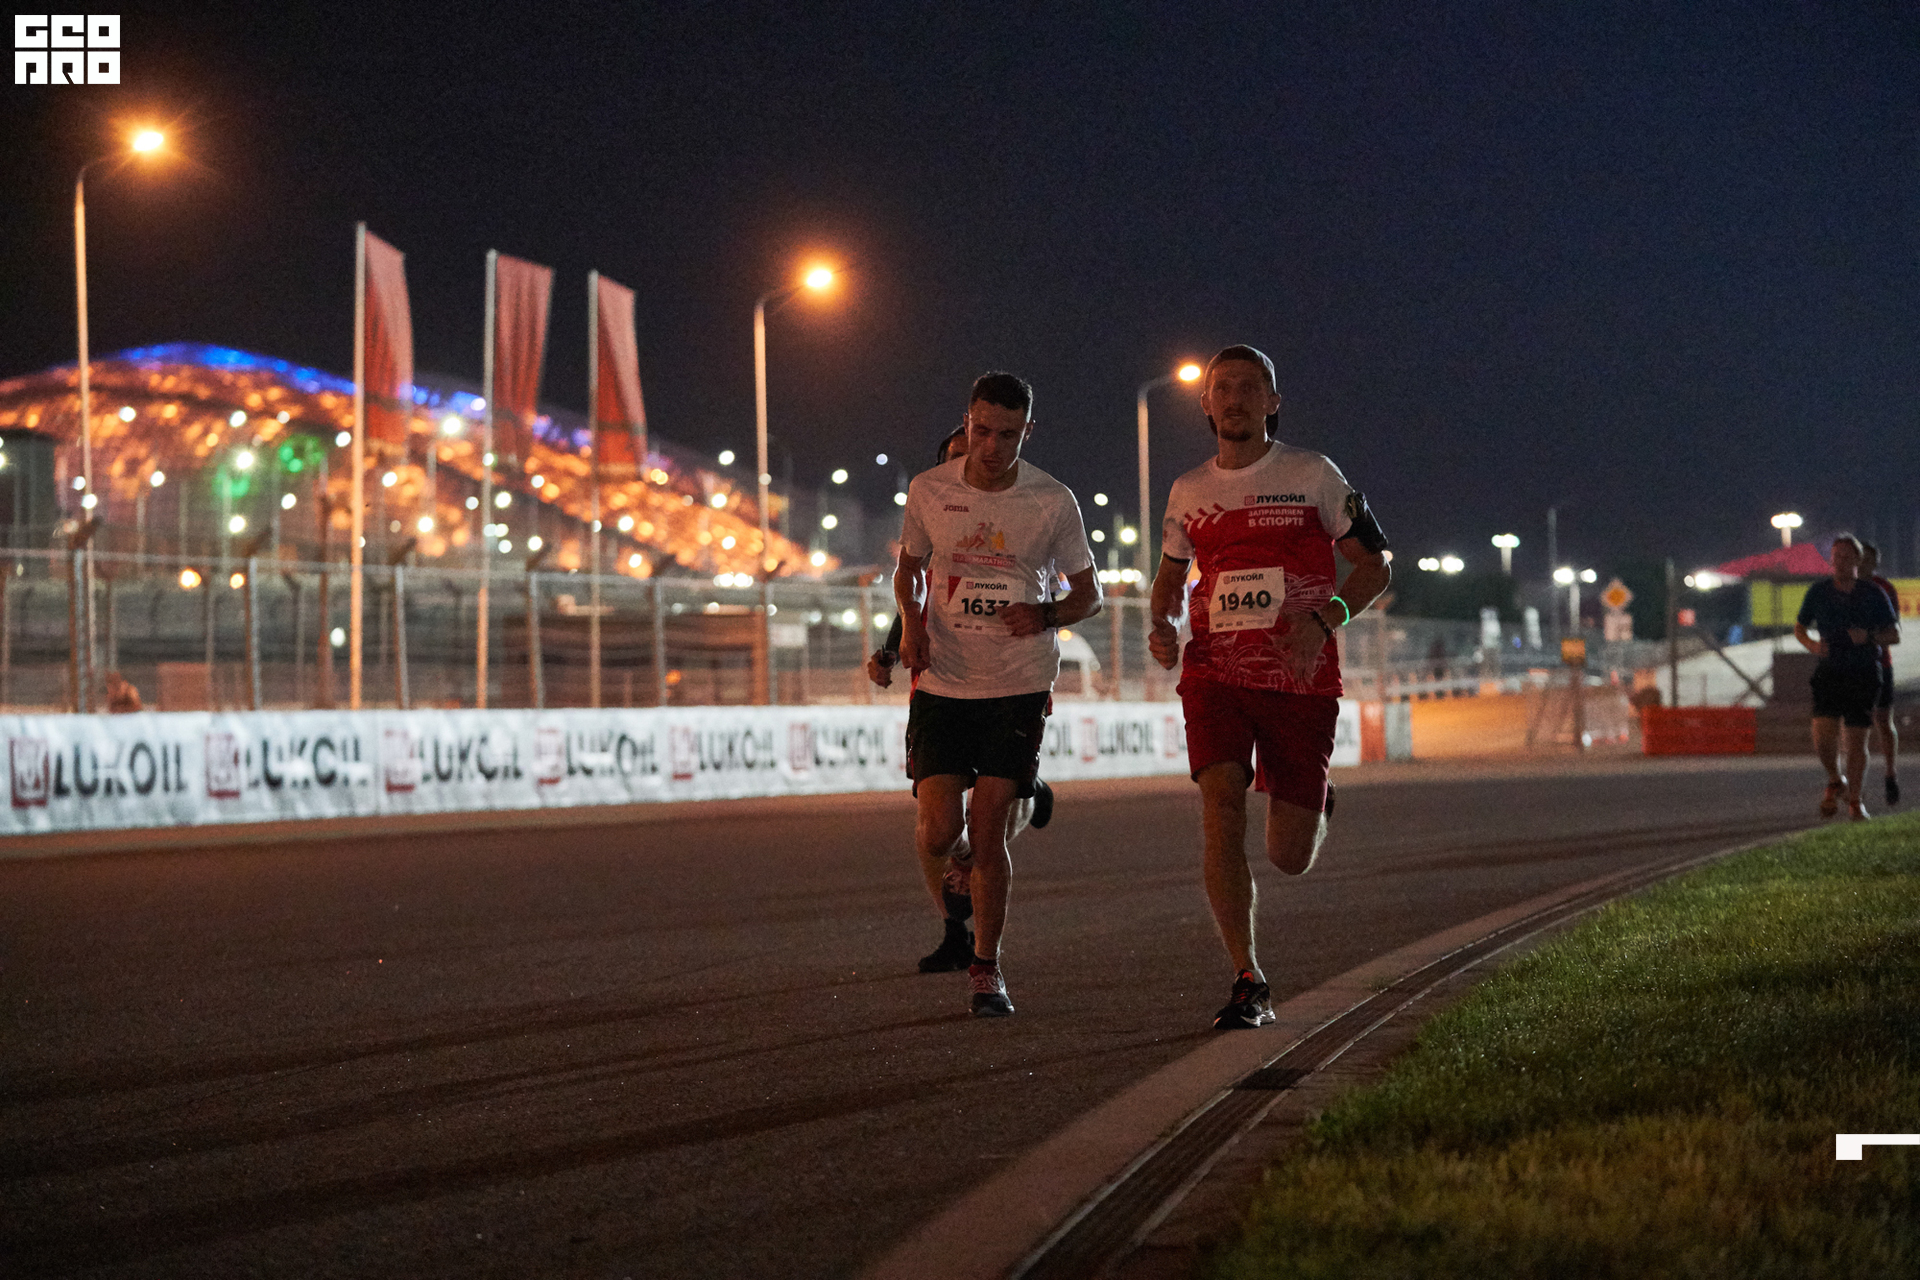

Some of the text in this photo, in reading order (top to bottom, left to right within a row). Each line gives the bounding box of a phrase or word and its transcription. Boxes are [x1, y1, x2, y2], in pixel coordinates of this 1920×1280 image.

[1256, 492, 1306, 504] ЛУКОЙЛ
[1248, 508, 1305, 518] ЗАПРАВЛЯЕМ
[1248, 516, 1305, 528] В СПОРТЕ
[1230, 573, 1264, 583] ЛУКОЙЛ
[973, 582, 1008, 591] ЛУКОЙЛ
[1218, 589, 1272, 612] 1940
[53, 740, 188, 798] LUKOIL
